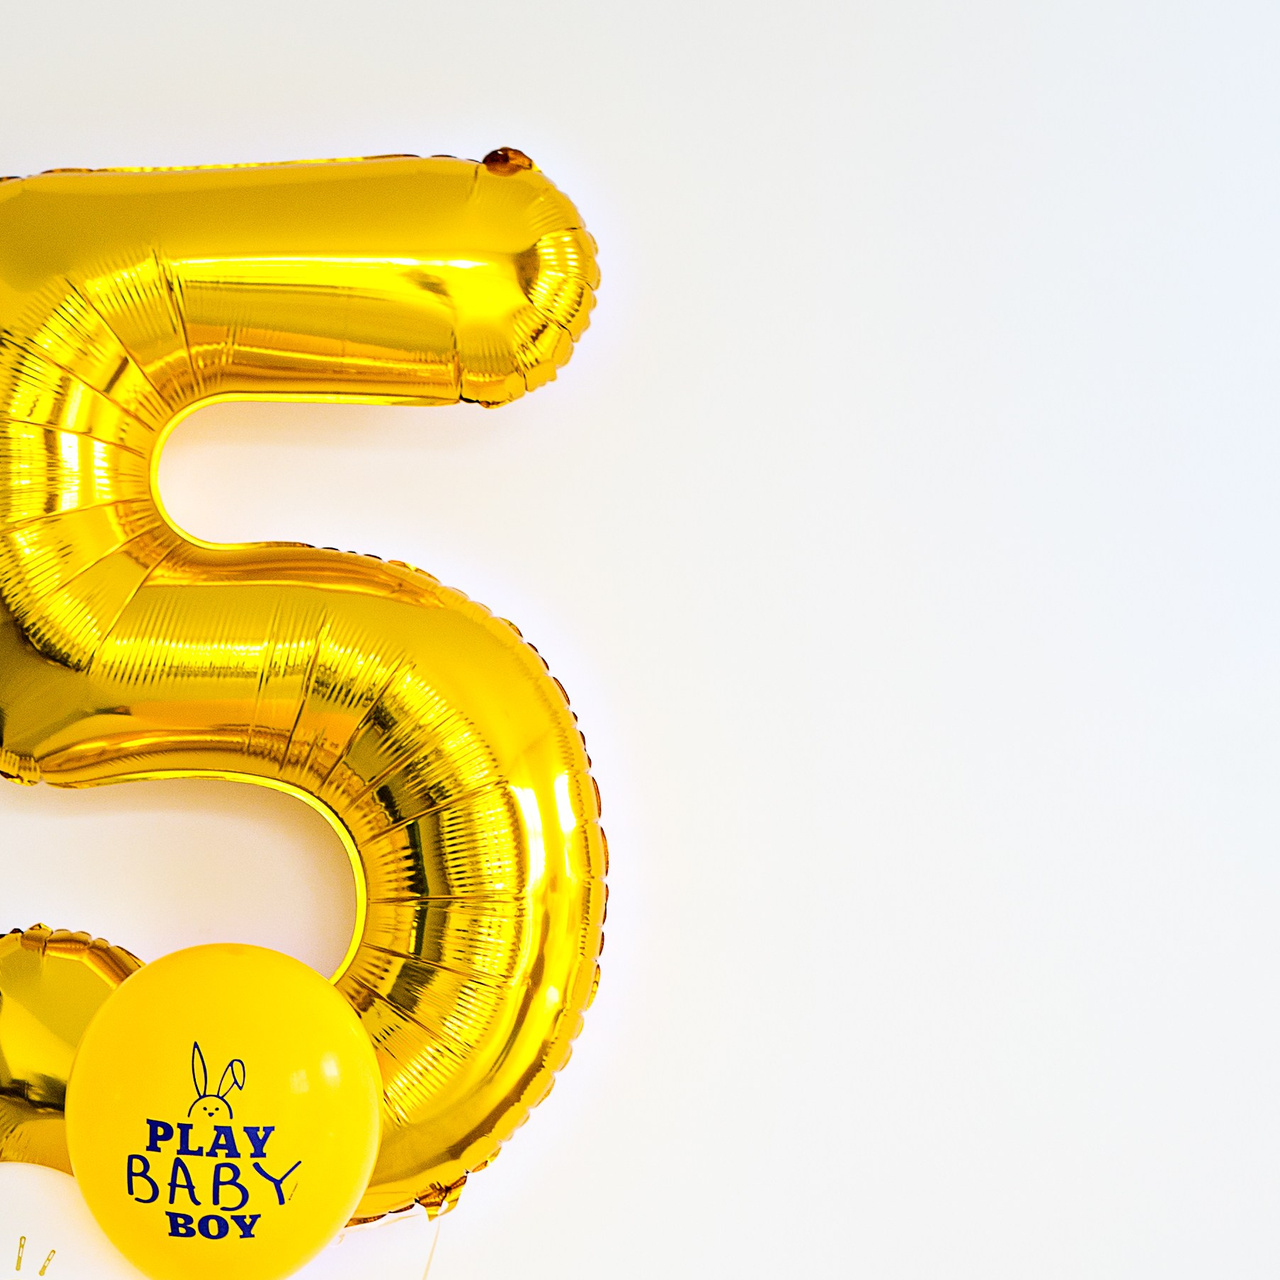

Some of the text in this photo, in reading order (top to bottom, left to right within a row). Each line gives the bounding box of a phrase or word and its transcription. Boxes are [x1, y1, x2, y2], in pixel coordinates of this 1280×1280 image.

[146, 1118, 275, 1159] PLAY
[127, 1154, 302, 1211] BABY
[165, 1211, 261, 1240] BOY
